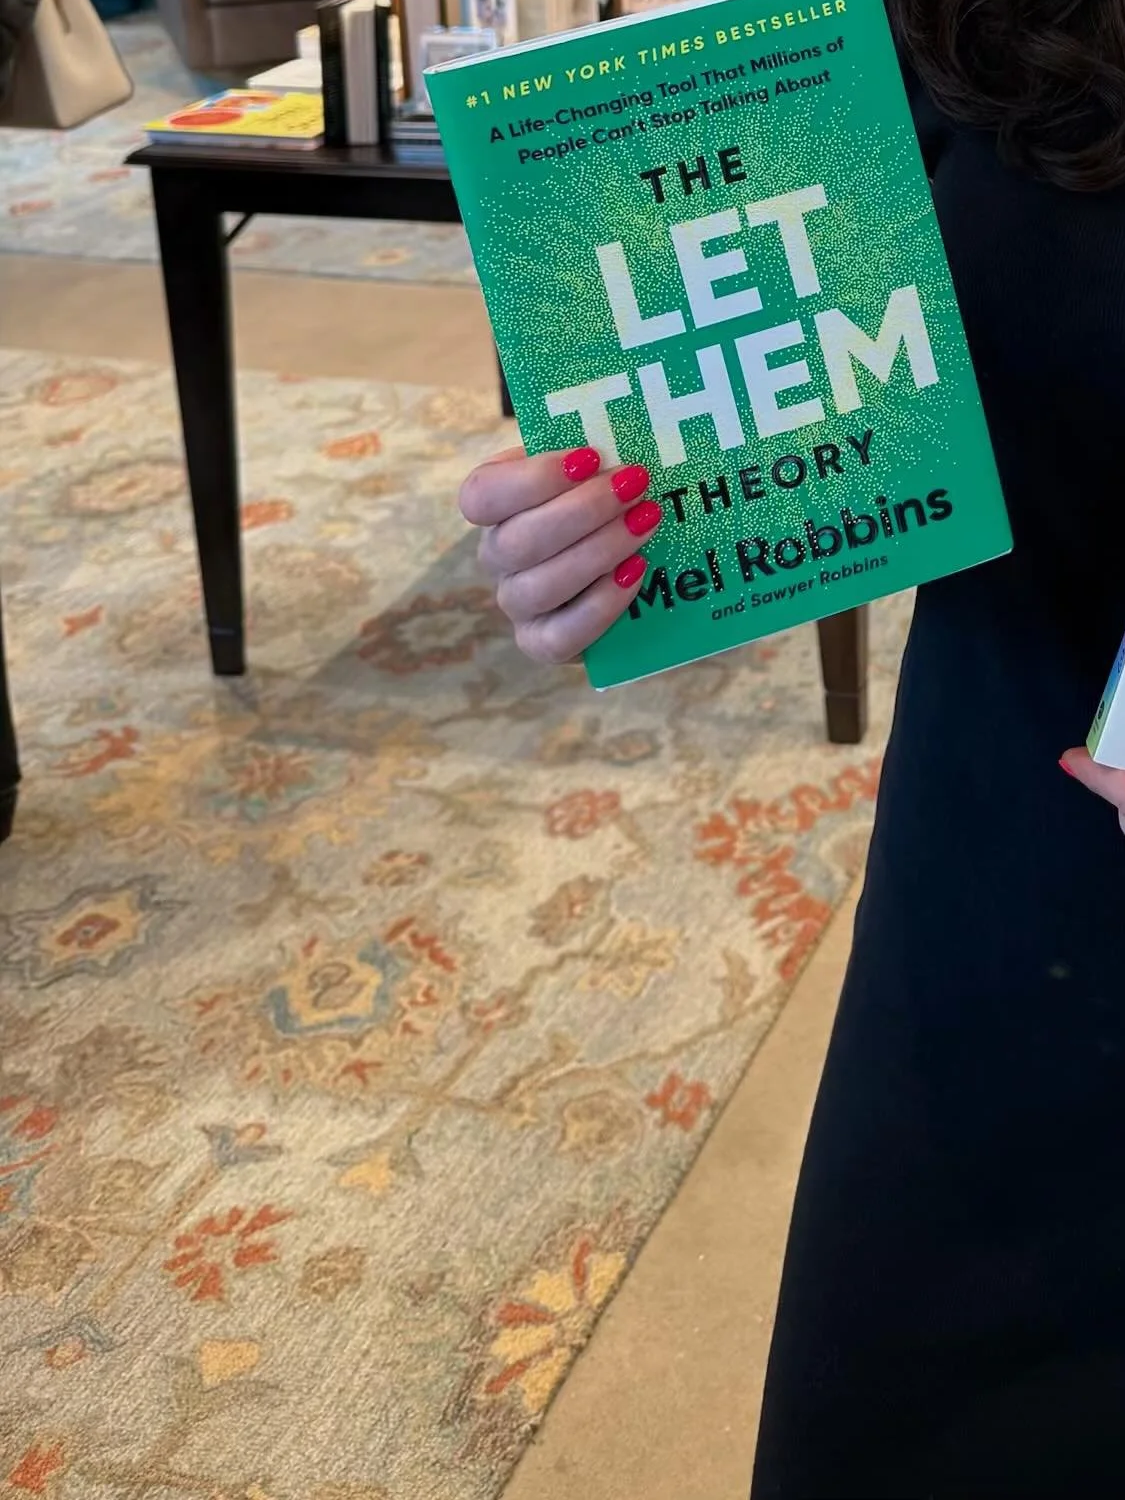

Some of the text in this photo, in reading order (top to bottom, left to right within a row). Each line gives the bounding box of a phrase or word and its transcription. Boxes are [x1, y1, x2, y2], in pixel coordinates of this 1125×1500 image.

[466, 0, 847, 108] #1 NEW YORK TIMES BESTSELLER
[490, 36, 844, 144] A Life-Changing Tool That Millions of
[518, 136, 588, 164] People
[651, 105, 697, 129] Stop
[700, 88, 769, 115] Talking
[775, 69, 831, 96] About
[640, 146, 747, 204] THE
[595, 183, 829, 351] LET
[545, 284, 940, 470] THEM
[661, 429, 875, 523] THEORY
[627, 488, 953, 620] Mel Robbins
[711, 554, 888, 622] and Sawyer Robbins
